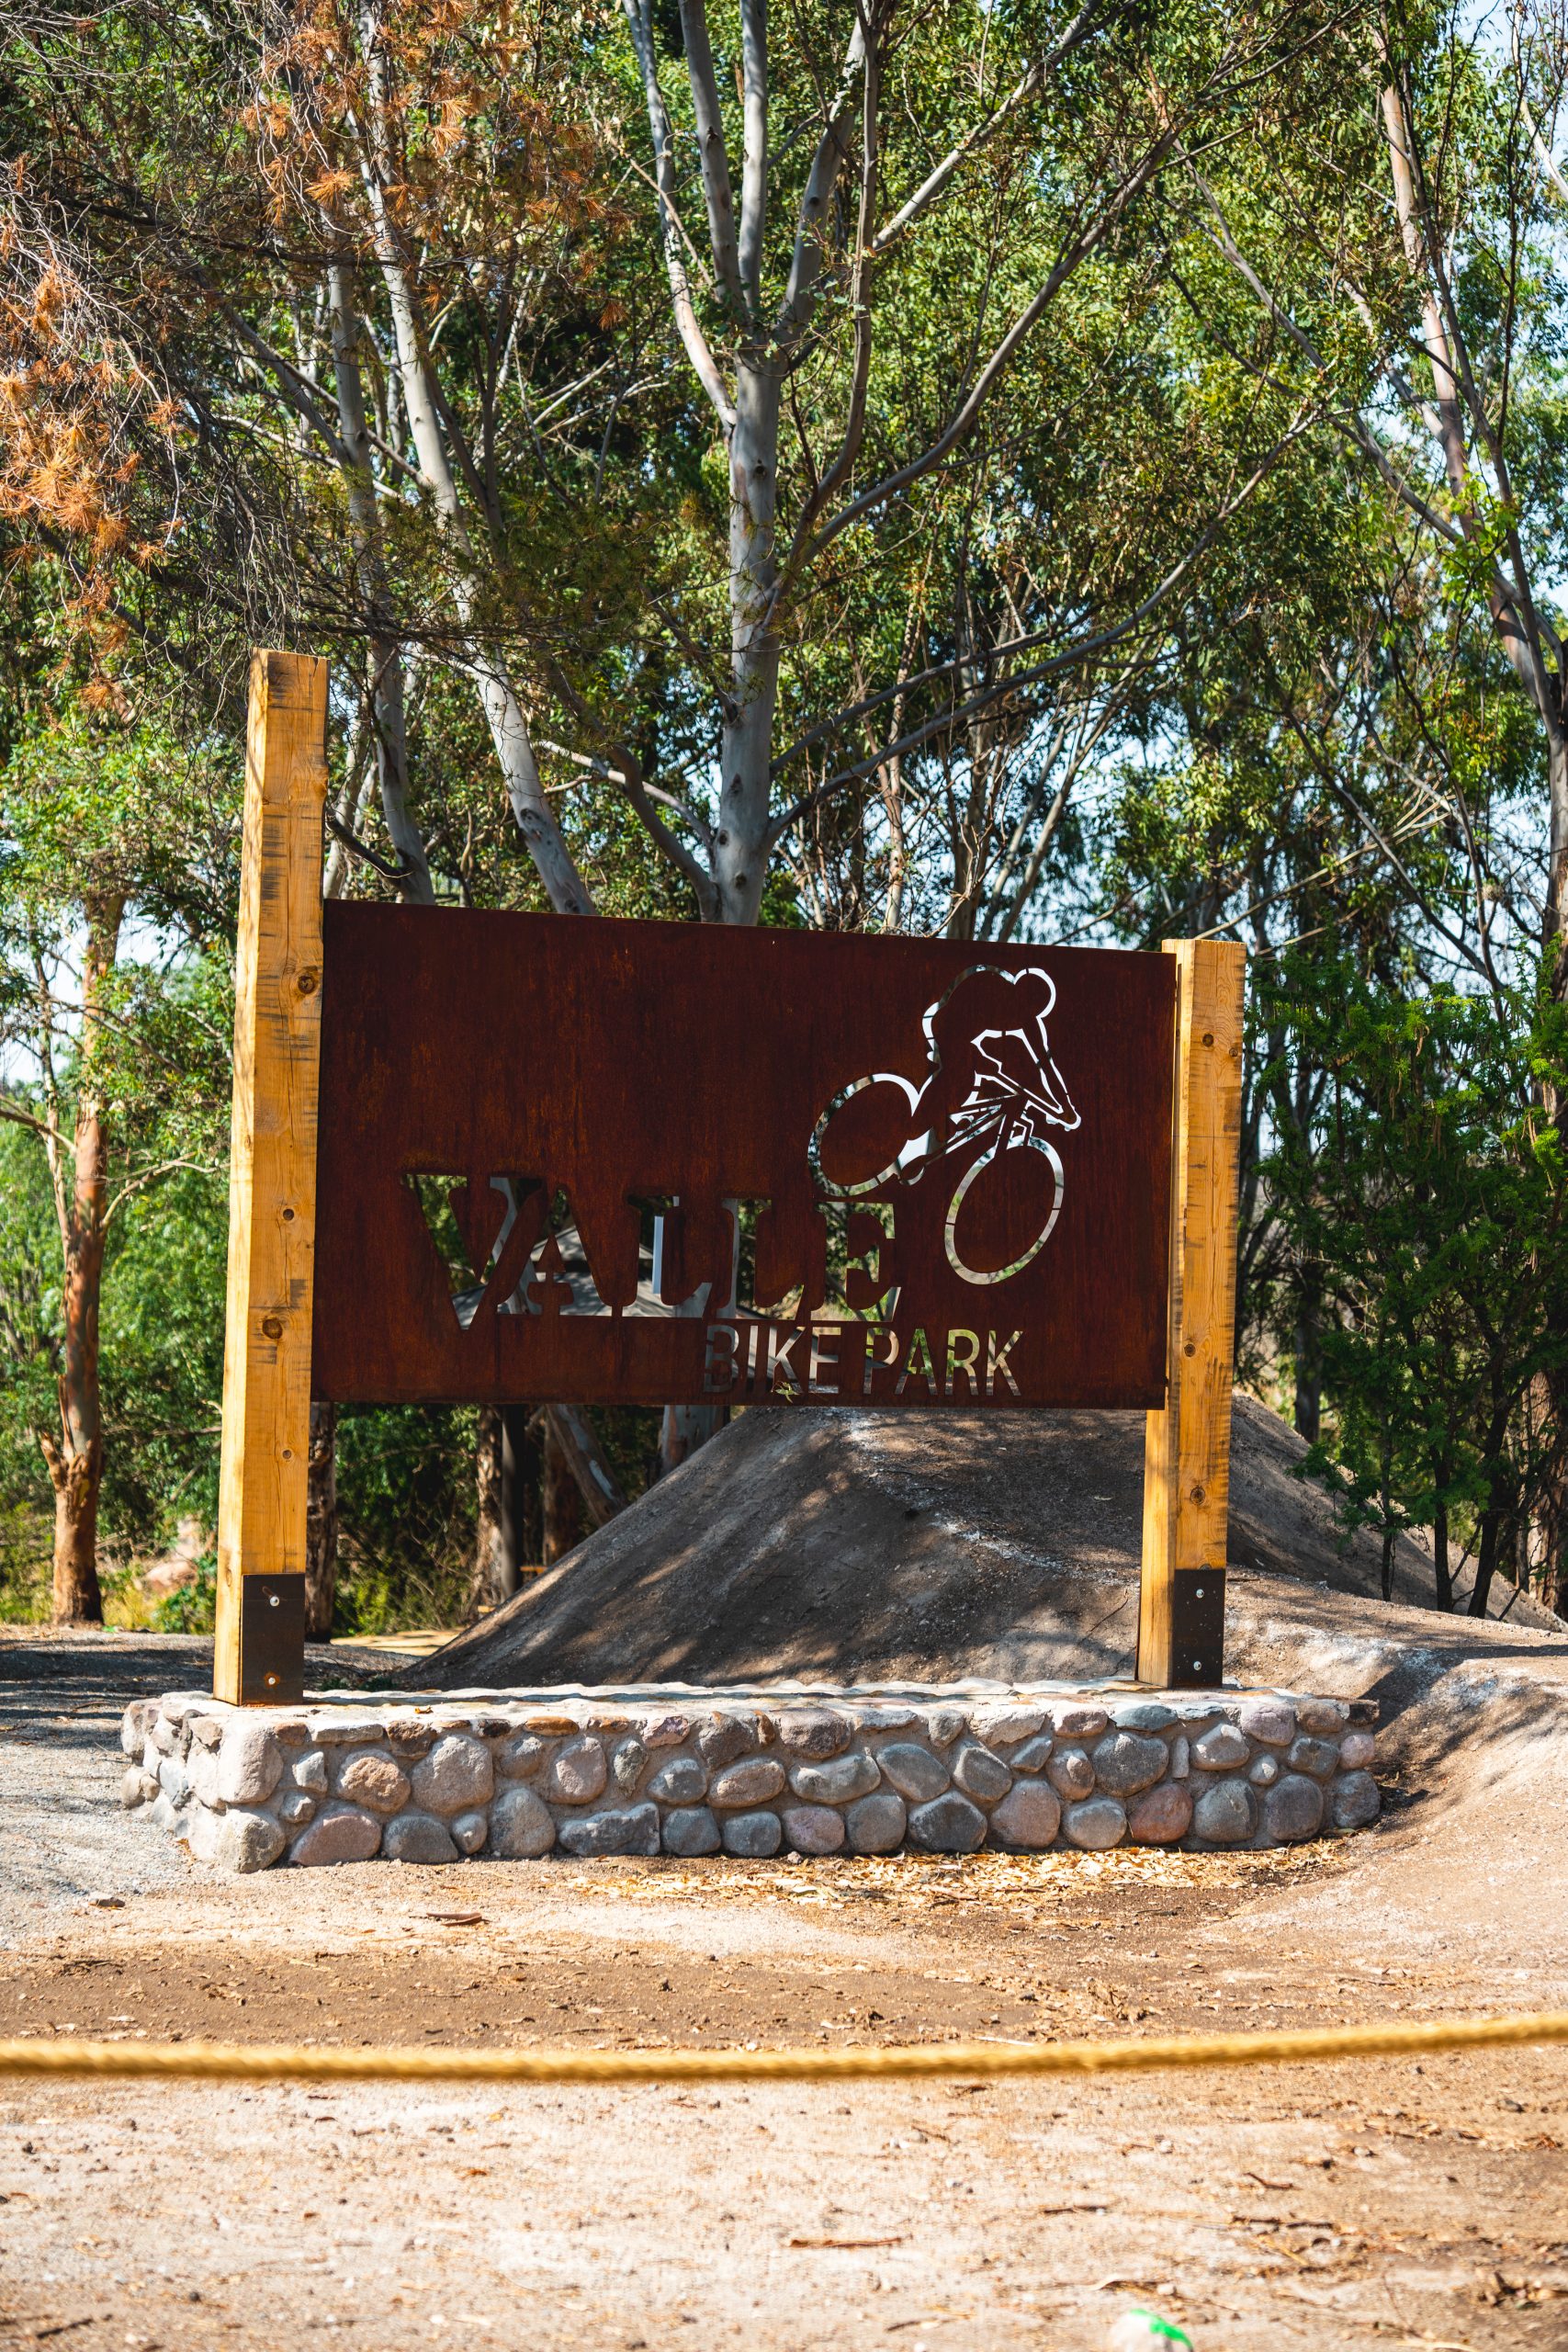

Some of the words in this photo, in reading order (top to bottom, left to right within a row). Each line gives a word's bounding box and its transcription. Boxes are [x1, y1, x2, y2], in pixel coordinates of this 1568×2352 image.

[401, 1173, 901, 1330] VALLE
[703, 1324, 841, 1395] BIKE
[862, 1328, 1023, 1396] PARK
